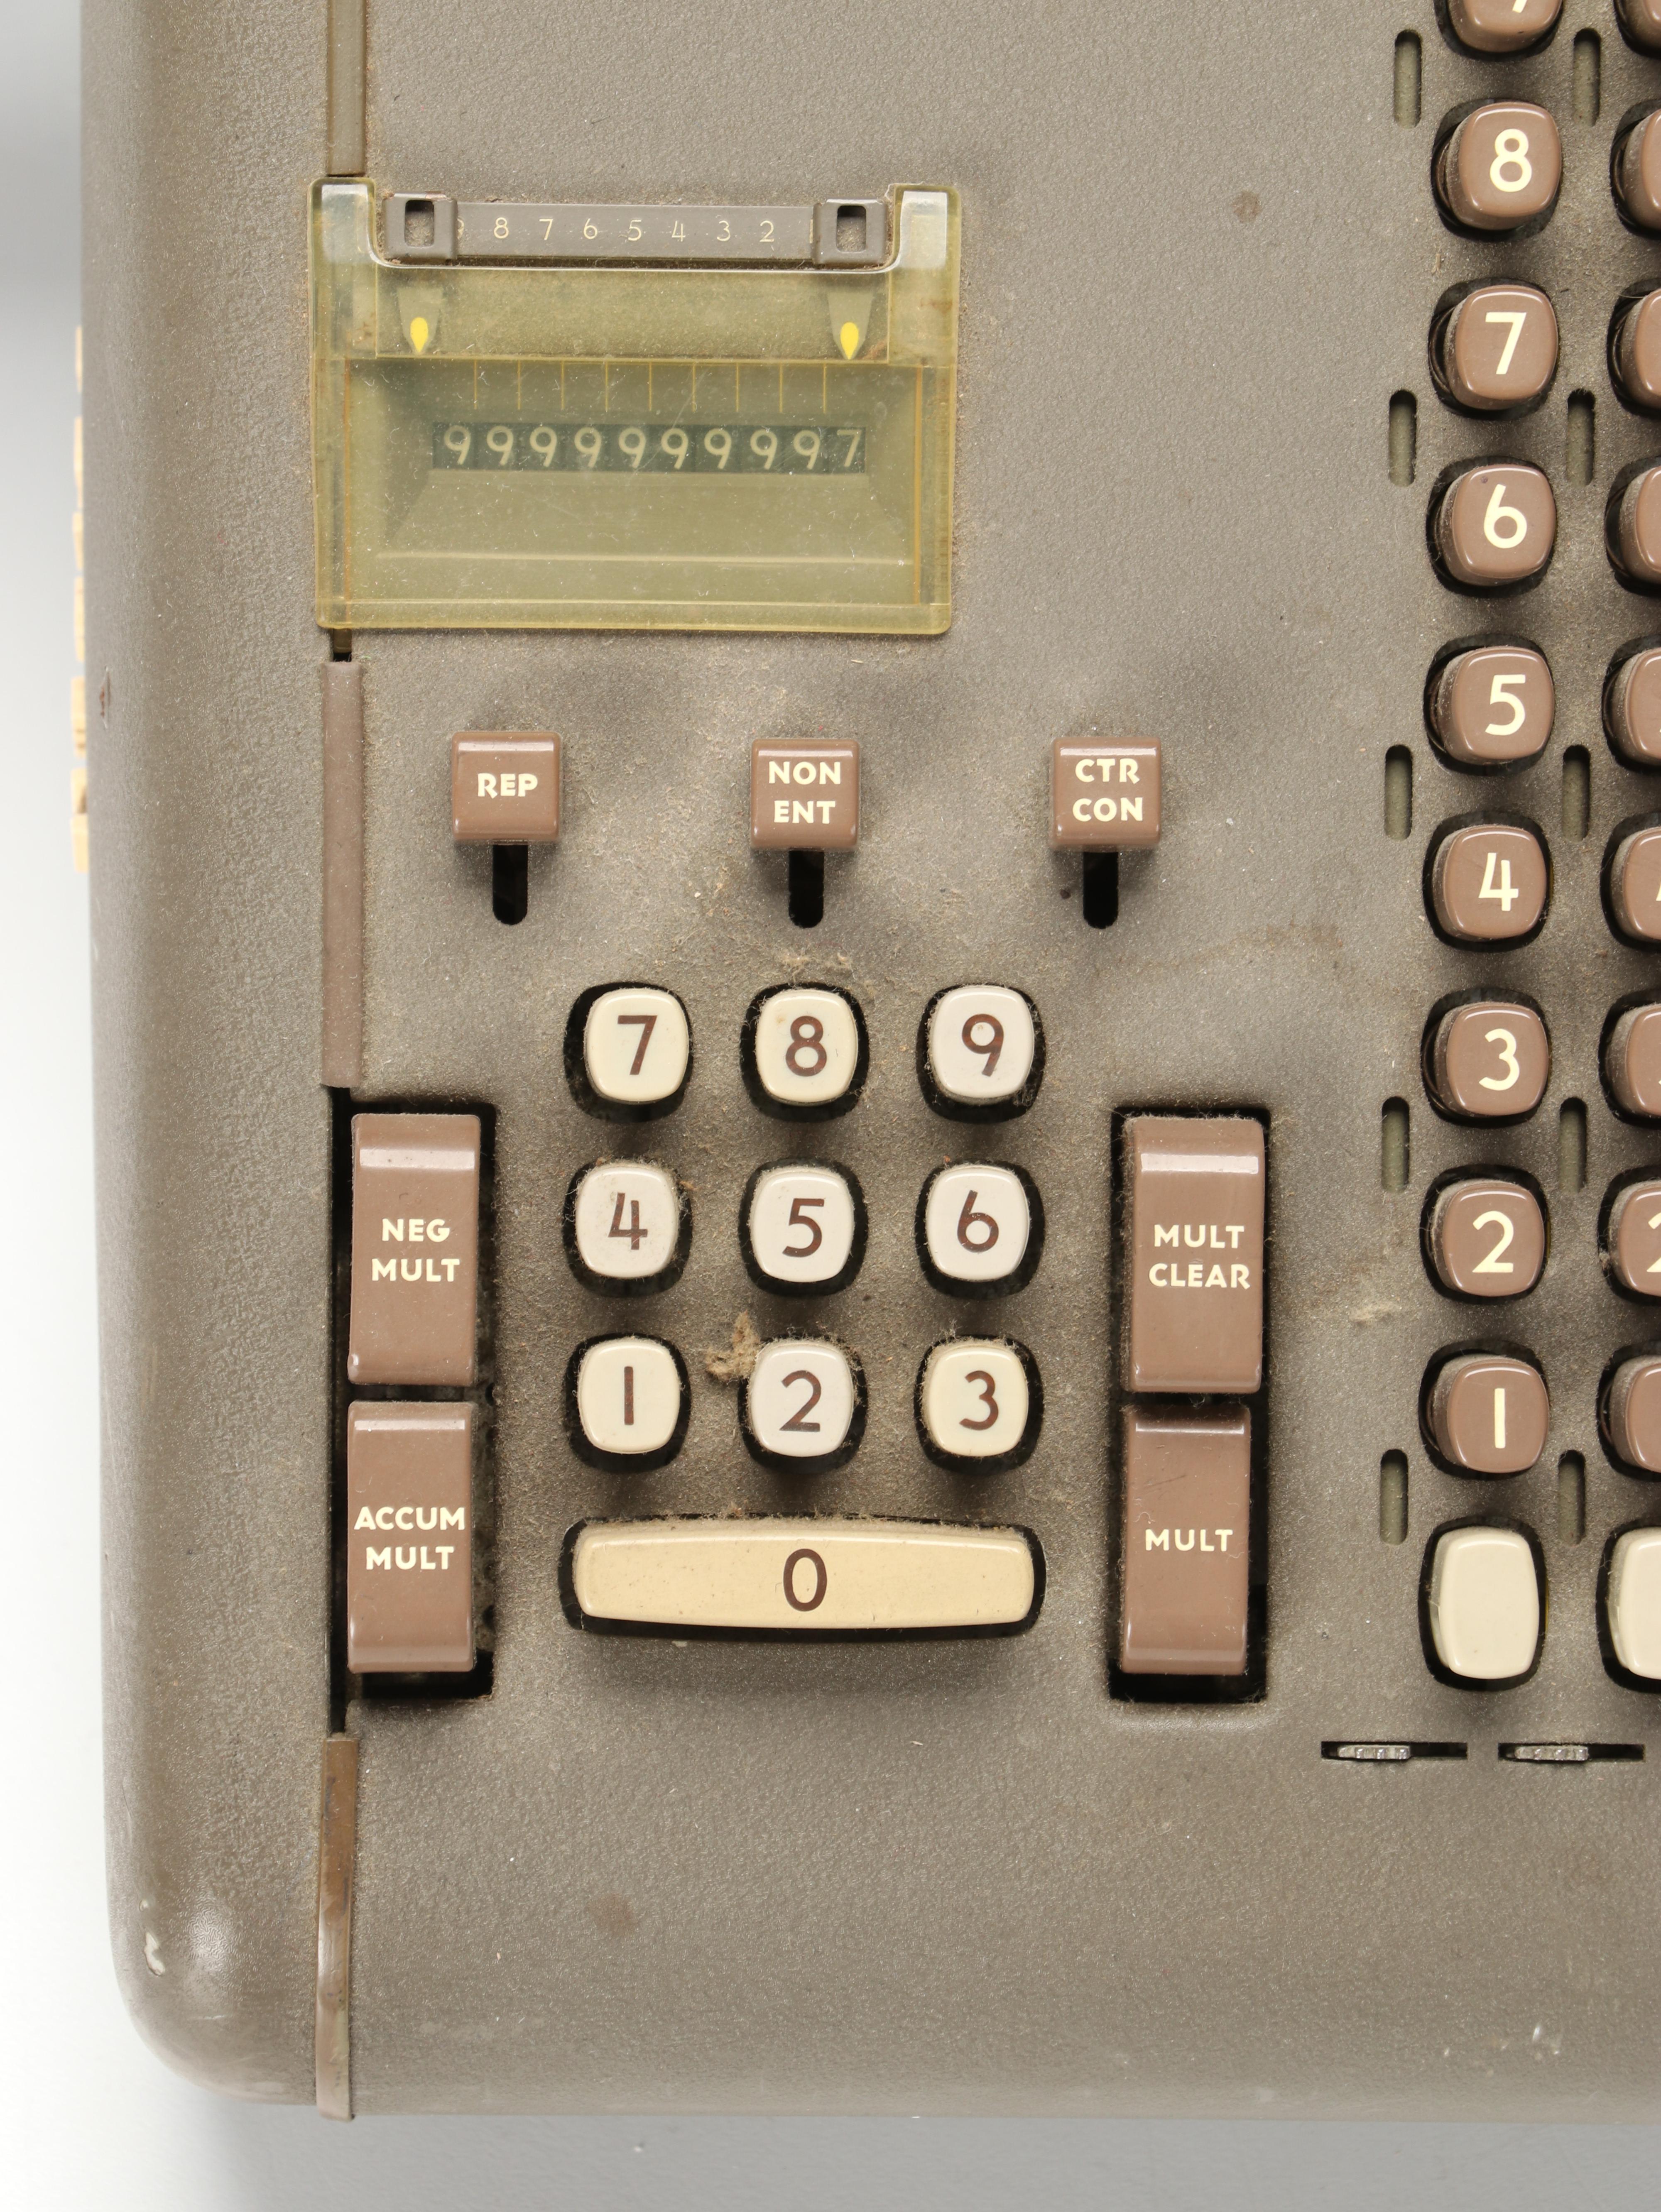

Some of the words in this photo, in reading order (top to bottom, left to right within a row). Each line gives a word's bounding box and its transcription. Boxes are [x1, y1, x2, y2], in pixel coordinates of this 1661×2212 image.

[1490, 129, 1532, 192] 8
[494, 217, 509, 238] 8
[539, 219, 553, 240] 7
[584, 218, 598, 239] 6
[628, 220, 641, 240] 5
[672, 221, 685, 241] 4
[717, 220, 730, 241] 3
[760, 220, 774, 242] 2
[1486, 312, 1526, 374] 7
[1484, 484, 1527, 548] 6
[1485, 675, 1525, 735] 5
[478, 773, 537, 798] REP
[769, 761, 840, 784] NON
[1075, 758, 1140, 784] CTR
[774, 800, 835, 824] ENT
[1073, 798, 1142, 821] CON
[1479, 853, 1519, 911] 4
[618, 1015, 657, 1075] 7
[786, 1016, 827, 1077] 8
[962, 1014, 1004, 1076] 9
[1479, 1029, 1519, 1090] 3
[382, 1219, 450, 1242] NEG
[608, 1193, 648, 1250] 4
[783, 1198, 824, 1257] 5
[957, 1190, 999, 1252] 6
[1155, 1225, 1244, 1248] MULT
[1472, 1211, 1514, 1272] 2
[372, 1259, 460, 1282] MULT
[1149, 1263, 1250, 1289] CLEAR
[624, 1366, 634, 1425] 1
[780, 1370, 821, 1432] 2
[960, 1370, 999, 1430] 3
[1495, 1388, 1505, 1448] 1
[354, 1507, 465, 1530] ACCUM
[1146, 1529, 1232, 1551] MULT
[366, 1546, 454, 1569] MULT
[784, 1549, 827, 1611] 0
